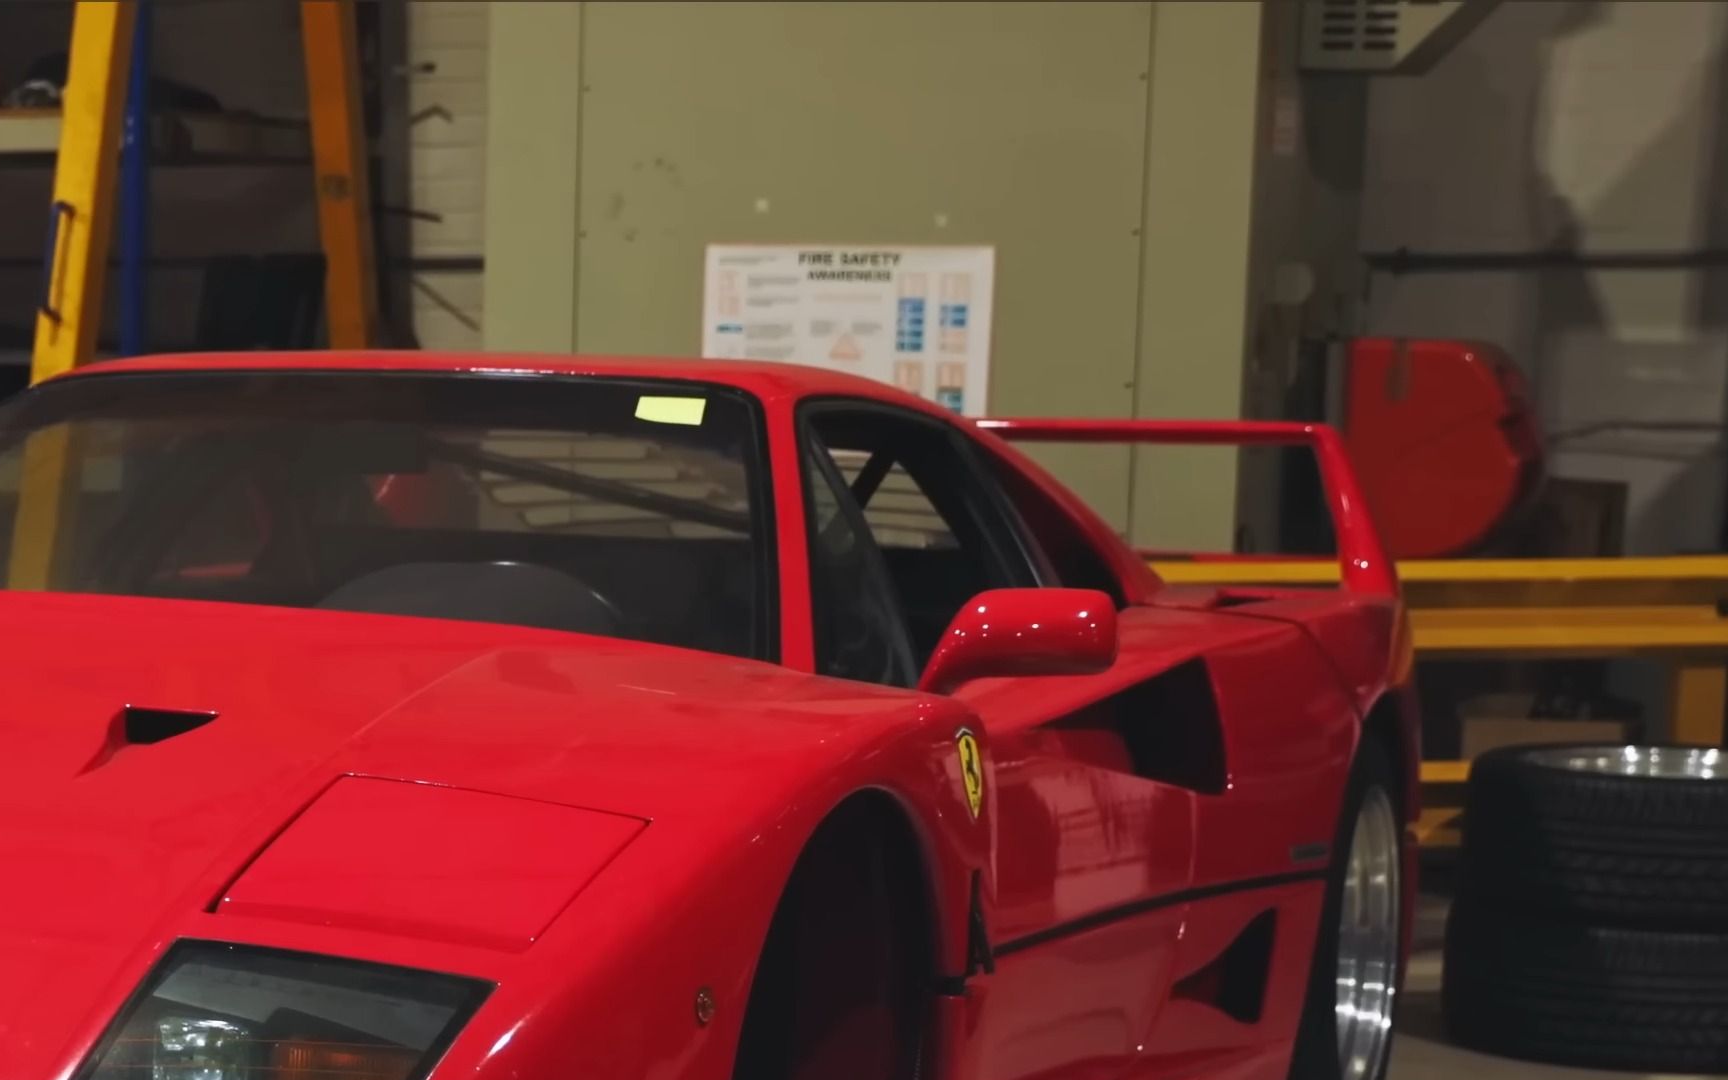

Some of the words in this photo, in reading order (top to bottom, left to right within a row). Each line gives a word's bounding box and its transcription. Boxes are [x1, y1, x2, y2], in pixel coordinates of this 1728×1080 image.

[797, 251, 833, 266] FIRE
[838, 251, 902, 266] SAFETY
[806, 269, 892, 282] AWARENESS
